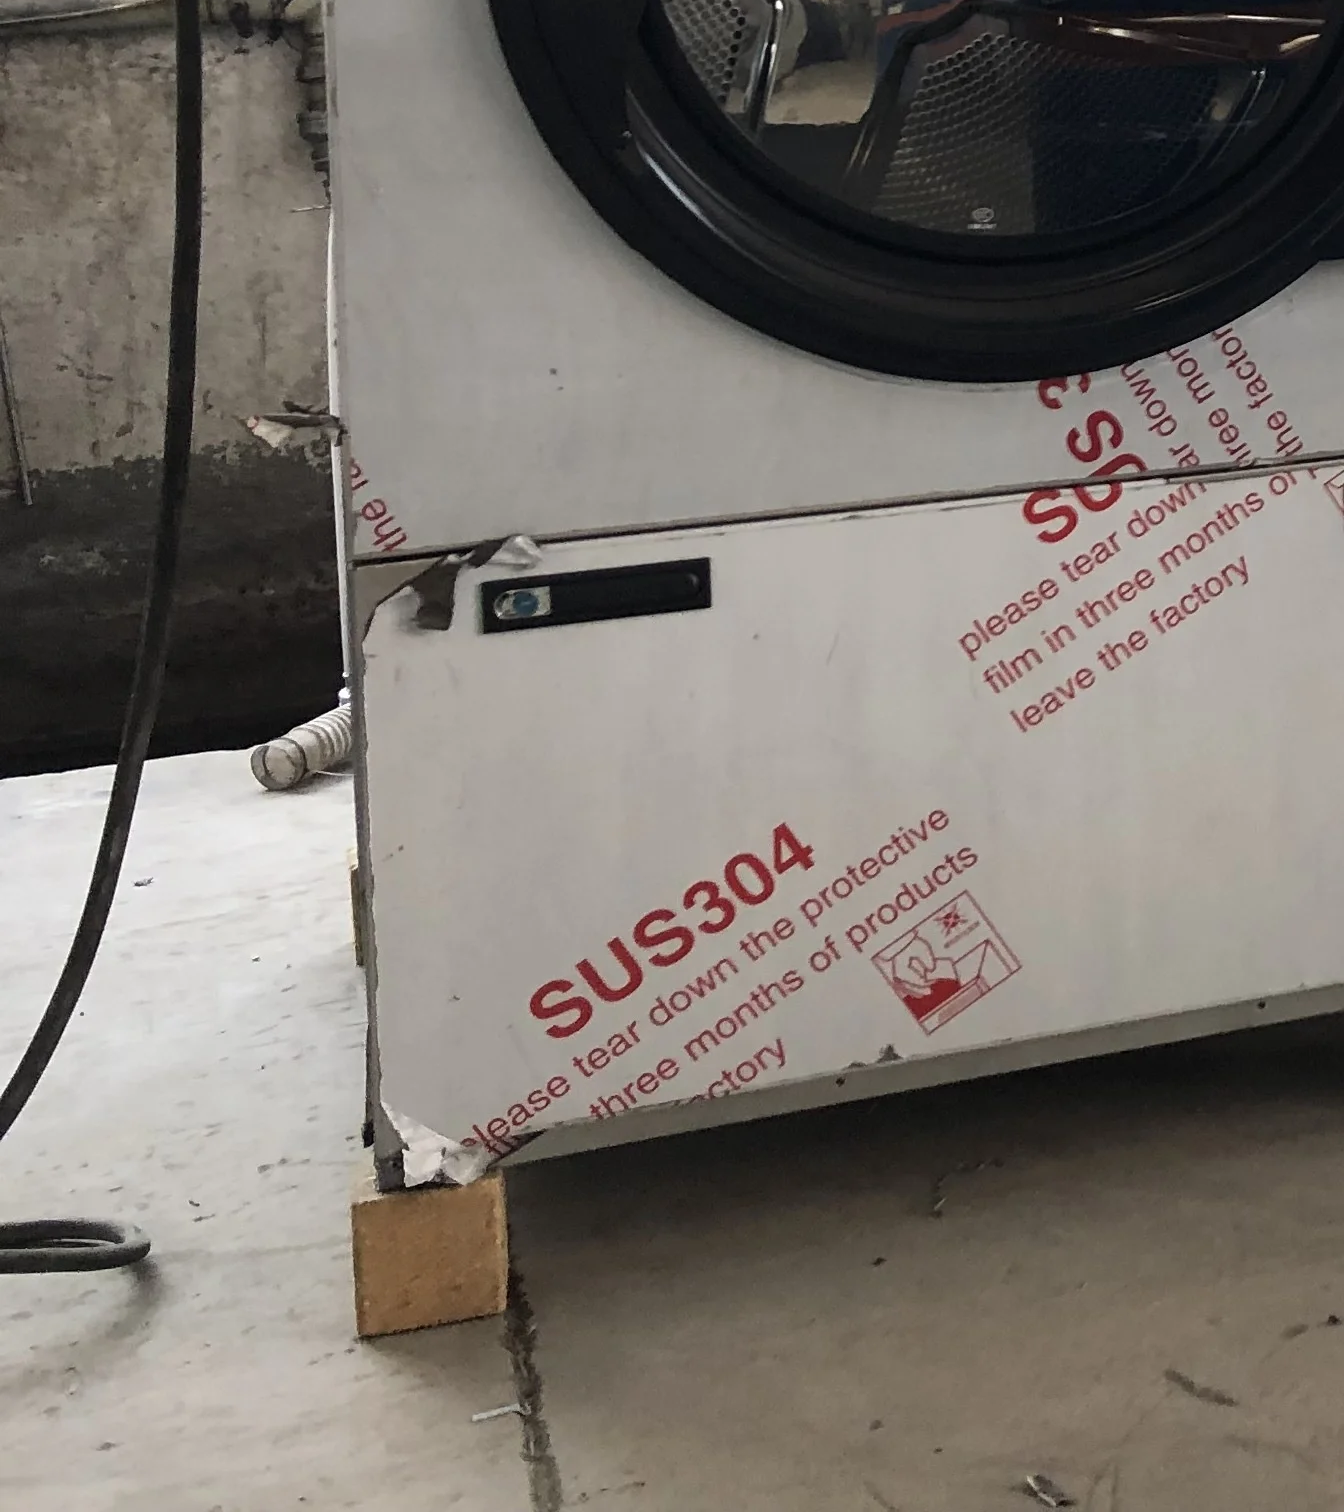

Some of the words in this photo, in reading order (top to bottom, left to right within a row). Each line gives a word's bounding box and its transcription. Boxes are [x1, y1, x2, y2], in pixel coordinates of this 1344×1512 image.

[360, 498, 408, 552] the
[957, 576, 1060, 662] please
[1060, 529, 1122, 584] tear
[982, 645, 1043, 695] film
[1041, 623, 1078, 655] in
[1075, 567, 1156, 631] three
[1157, 492, 1266, 575] months
[1009, 664, 1097, 734] leave
[1096, 627, 1150, 672] the
[1149, 554, 1251, 636] factory
[529, 822, 815, 1039] SUS304
[572, 1020, 640, 1078] tear
[648, 956, 739, 1027] down
[739, 916, 796, 965] the
[799, 807, 951, 922] protective
[683, 969, 806, 1062] months
[808, 934, 842, 972] of
[844, 843, 980, 952] products
